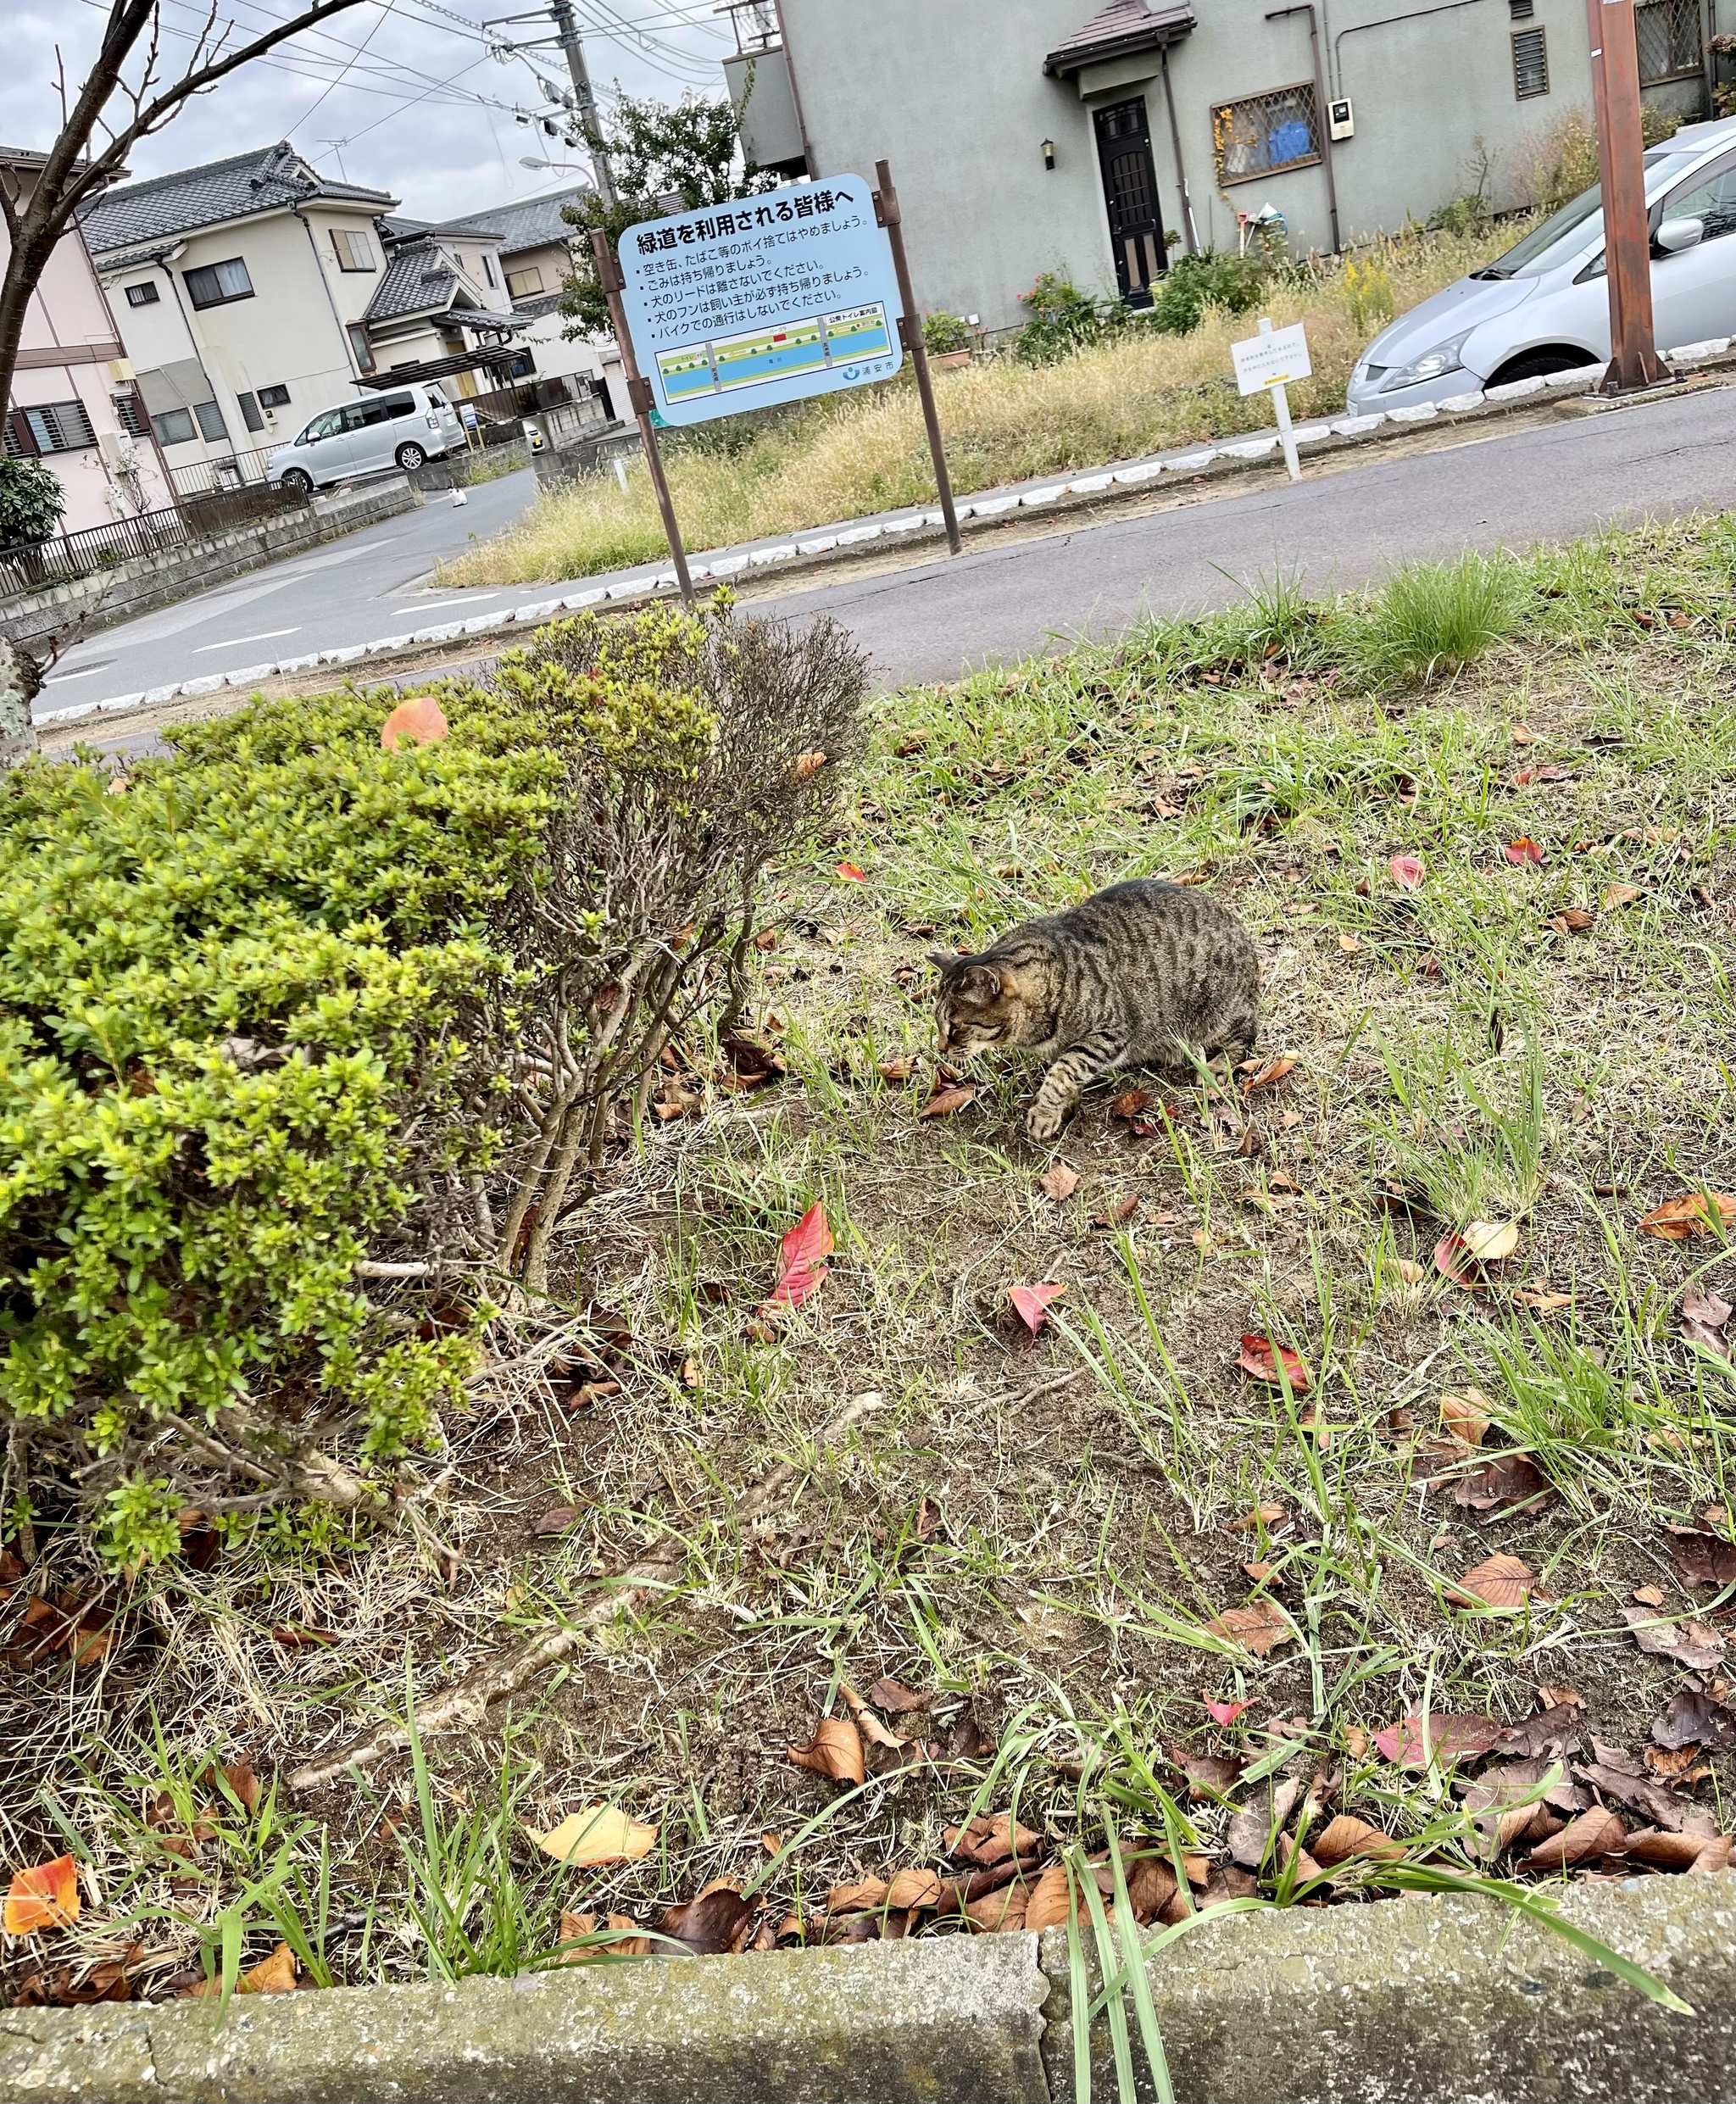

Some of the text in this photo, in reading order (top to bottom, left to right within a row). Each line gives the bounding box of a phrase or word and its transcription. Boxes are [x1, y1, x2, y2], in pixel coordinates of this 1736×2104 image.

[636, 190, 854, 255] 緑道を利用される皆様へ
[647, 257, 772, 292] ごみは持ち帰りましょう。
[862, 361, 894, 377] 浦安市
